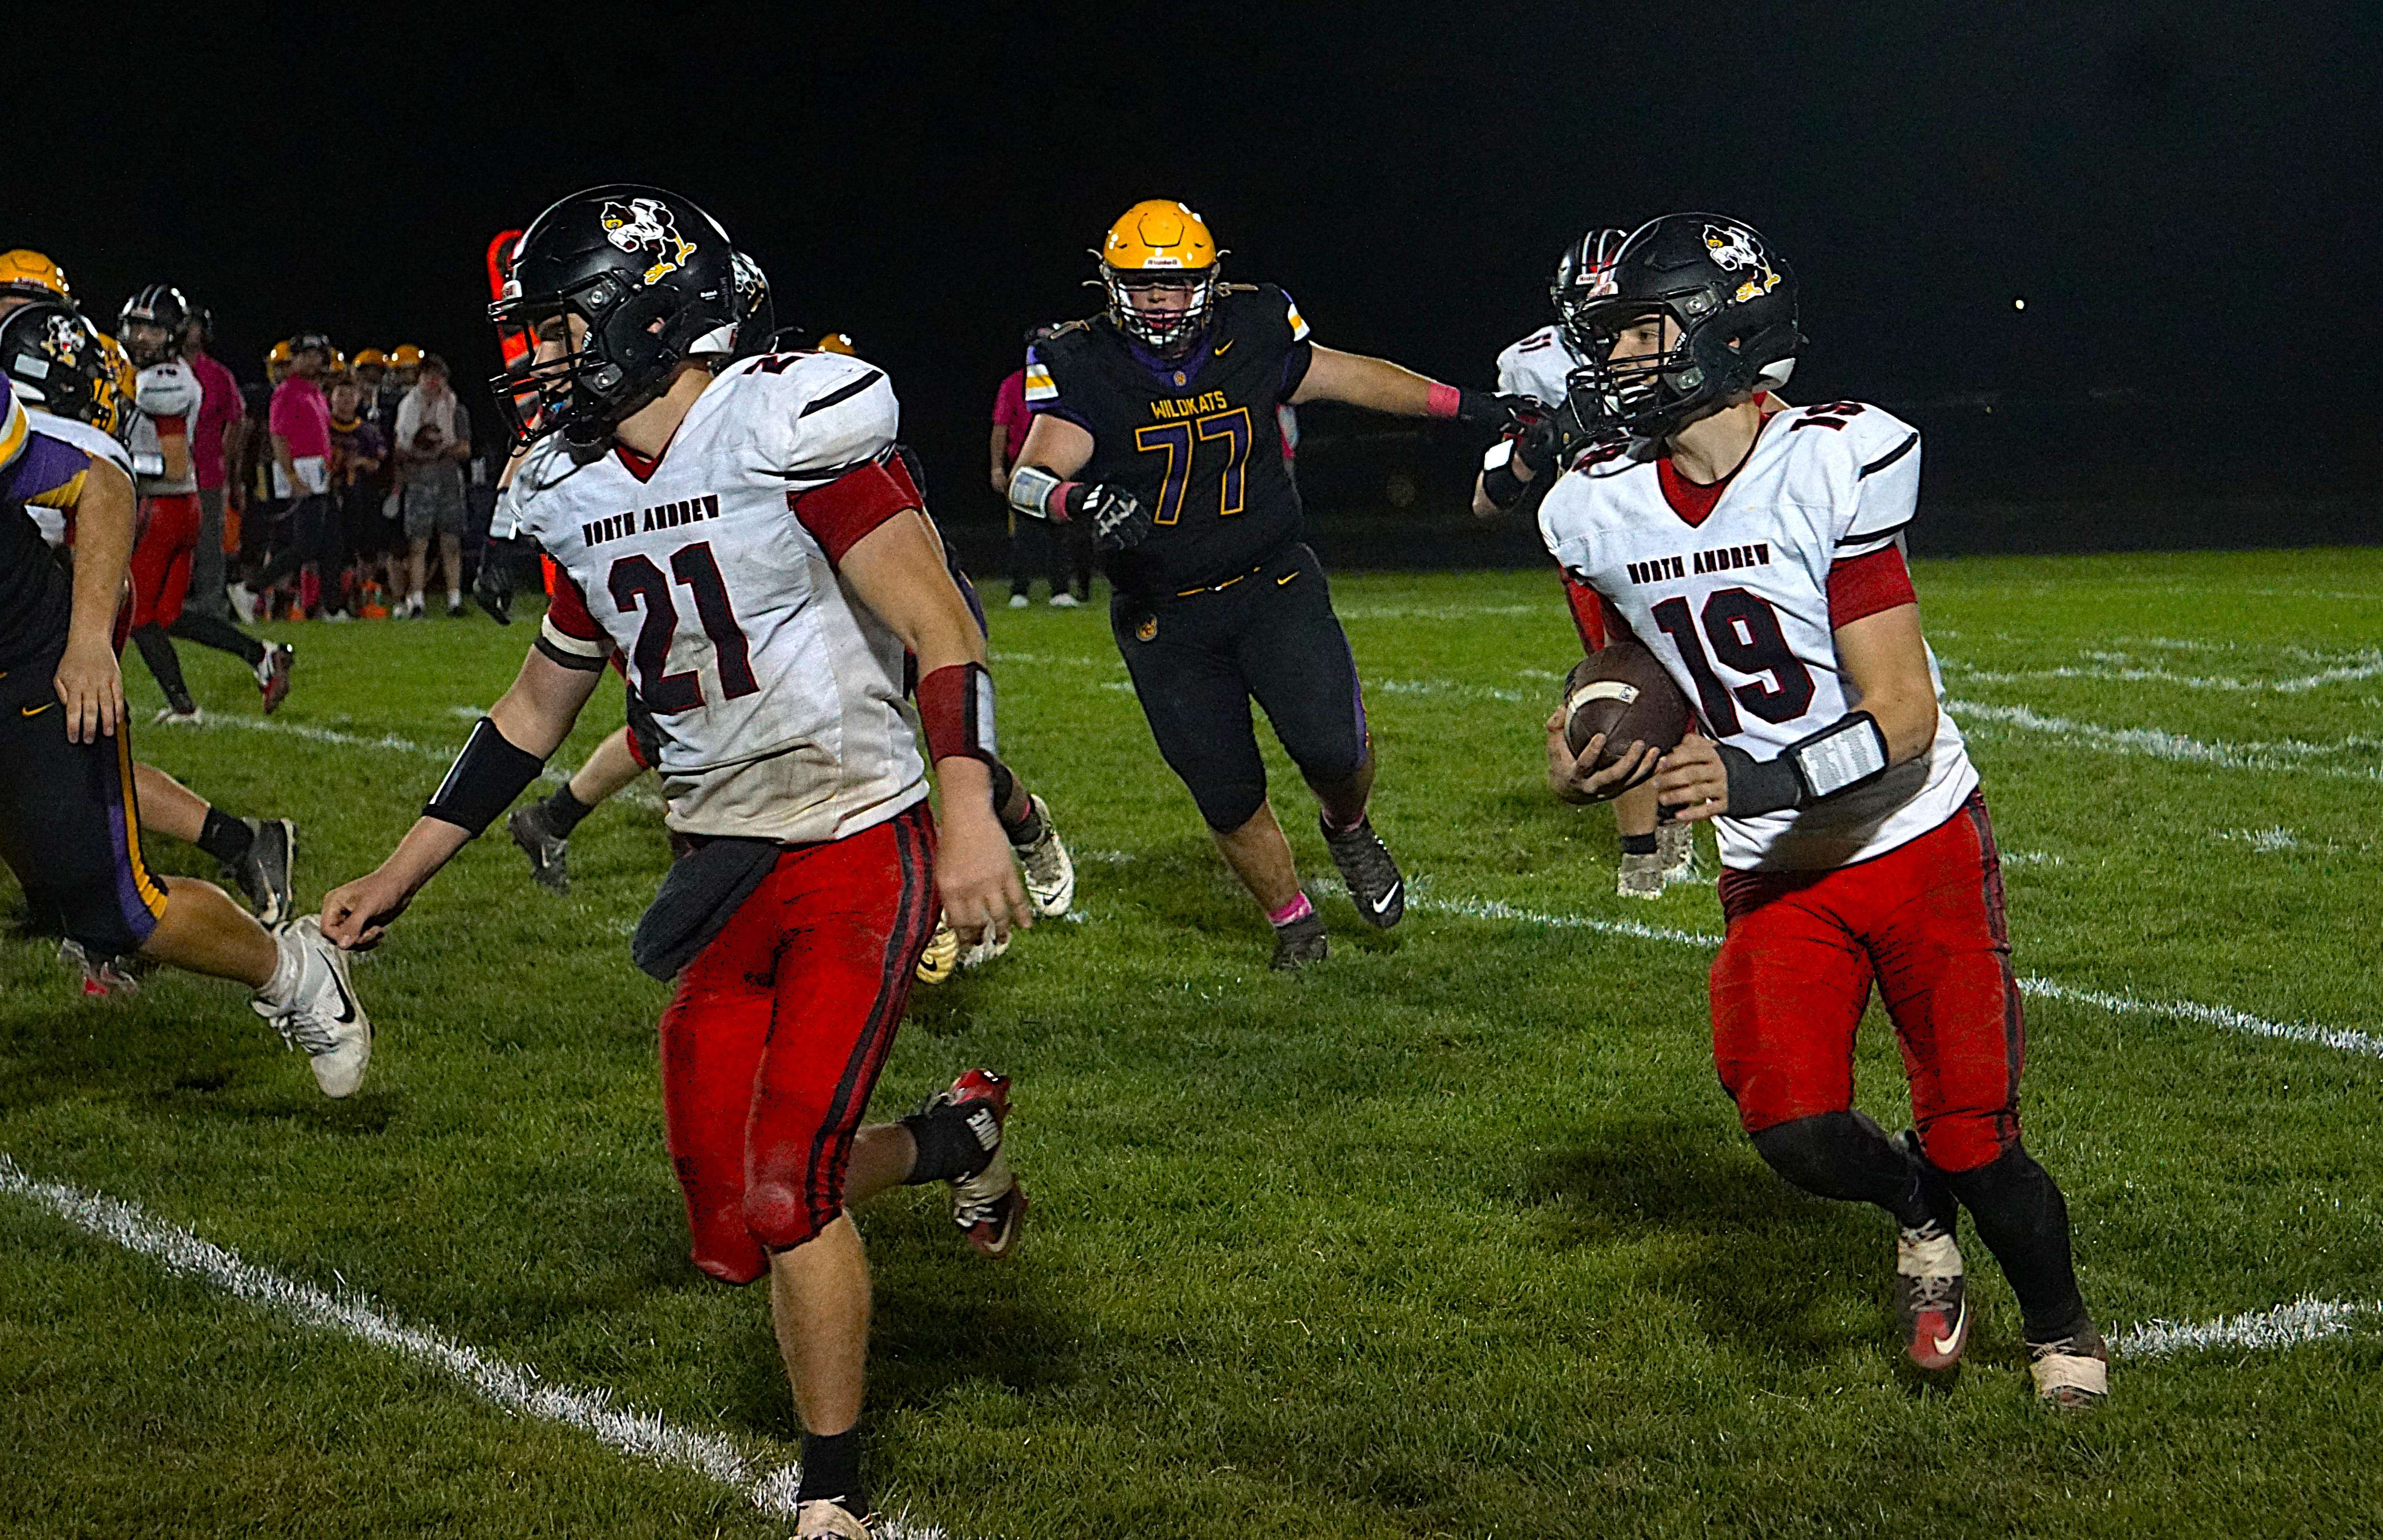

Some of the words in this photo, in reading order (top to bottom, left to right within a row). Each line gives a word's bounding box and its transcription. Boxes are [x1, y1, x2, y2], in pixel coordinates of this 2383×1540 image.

[1151, 391, 1227, 419] WILDKATS
[1135, 407, 1252, 525] 77
[582, 511, 636, 547] NORTH
[643, 494, 720, 532] ANDREW
[1627, 556, 1685, 585] NORTH
[1694, 543, 1770, 574] ANDREW
[608, 541, 760, 716] 21
[1651, 587, 1816, 738] 19
[965, 1107, 1000, 1151] NIKE
